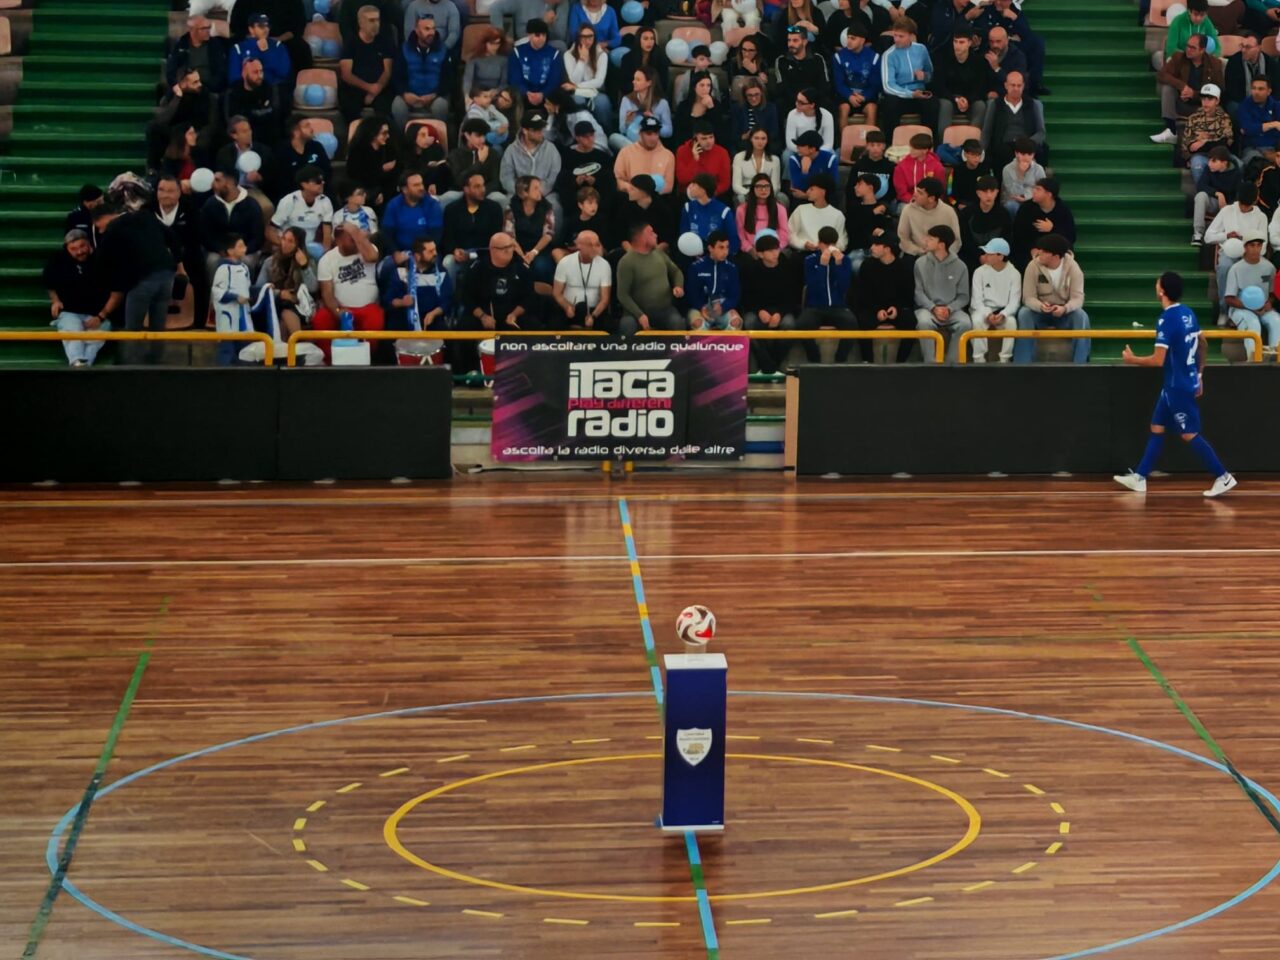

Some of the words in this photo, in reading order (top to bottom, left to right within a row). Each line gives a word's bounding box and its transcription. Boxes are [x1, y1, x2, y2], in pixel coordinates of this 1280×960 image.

[500, 342, 527, 351] non
[532, 341, 597, 351] ascoltare
[601, 342, 628, 351] una
[632, 341, 666, 351] radio
[670, 342, 744, 353] qualunque
[567, 409, 675, 437] radio
[502, 446, 554, 455] ascolta
[558, 446, 570, 455] la
[574, 445, 609, 455] radio
[613, 445, 666, 455] diversa
[670, 445, 700, 454] dalle
[704, 445, 735, 454] altre
